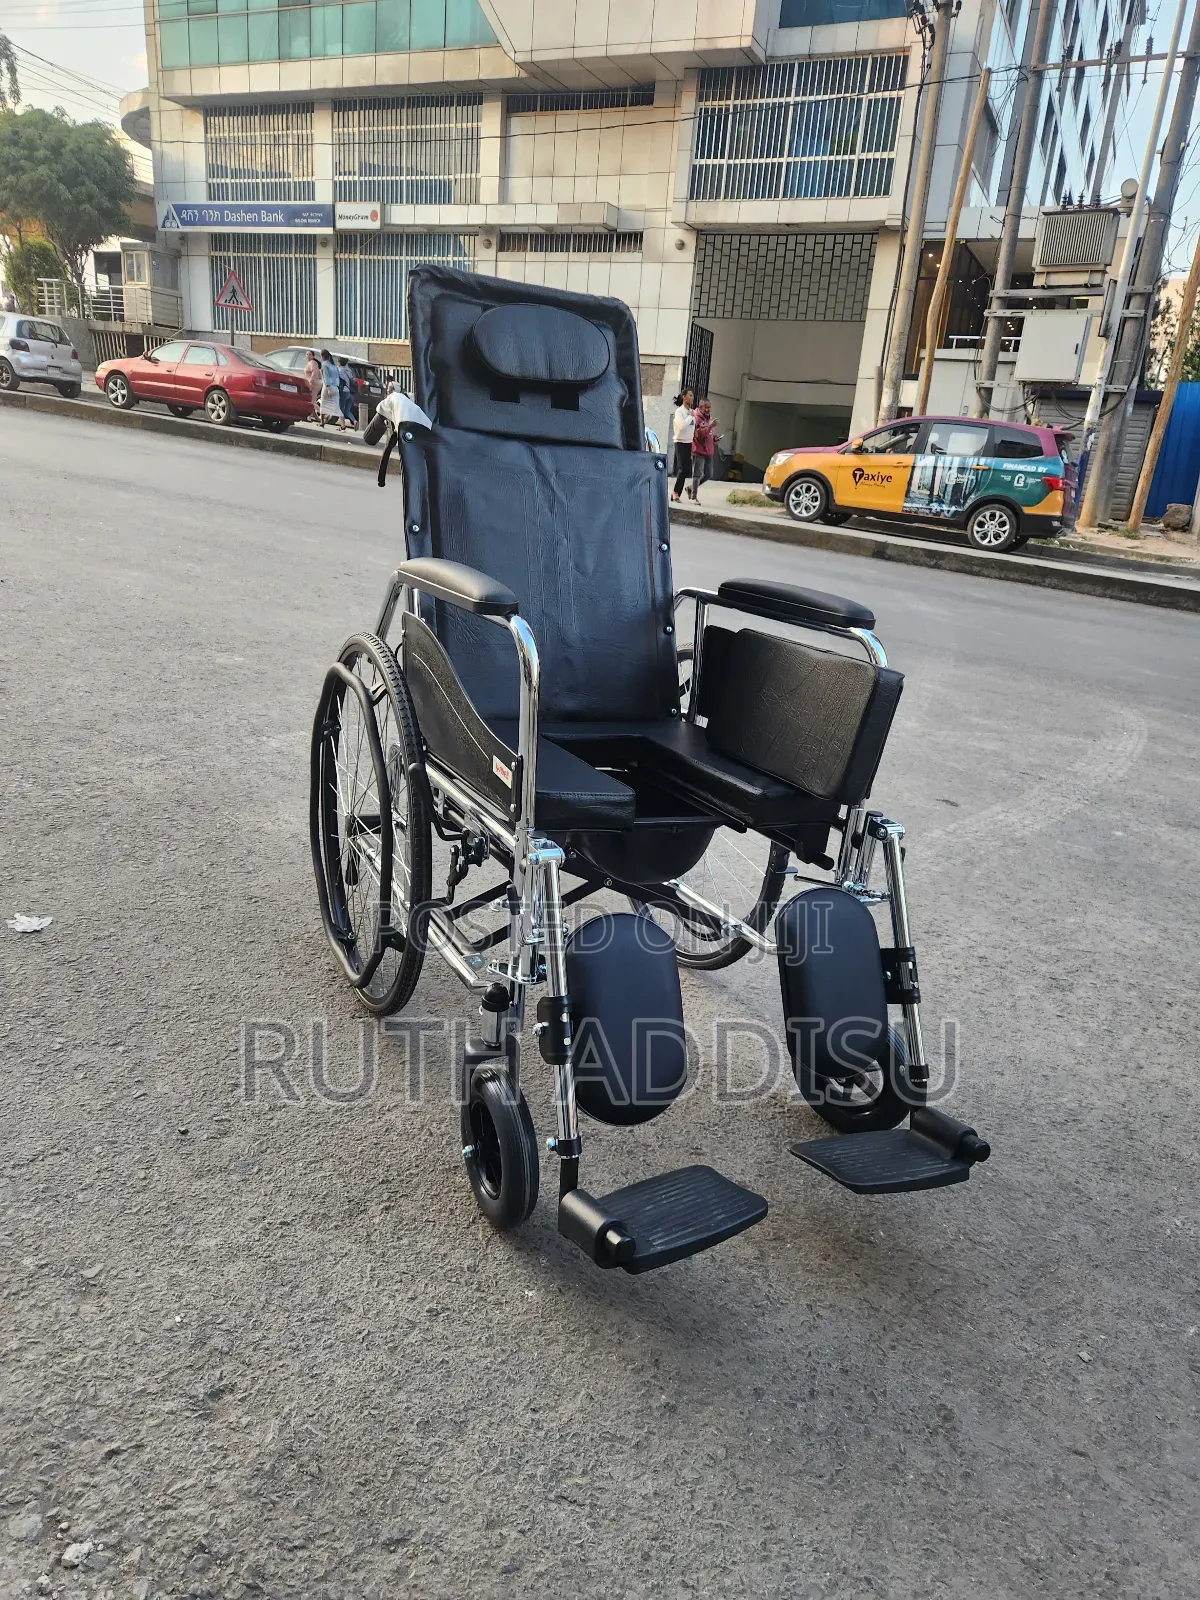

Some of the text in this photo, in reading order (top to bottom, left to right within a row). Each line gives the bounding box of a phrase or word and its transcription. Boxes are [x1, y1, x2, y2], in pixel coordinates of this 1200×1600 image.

[224, 210, 285, 223] Dashen Bank
[338, 213, 369, 221] MoneyGram
[1003, 462, 1036, 472] FINANCED
[852, 467, 893, 486] Taxiye
